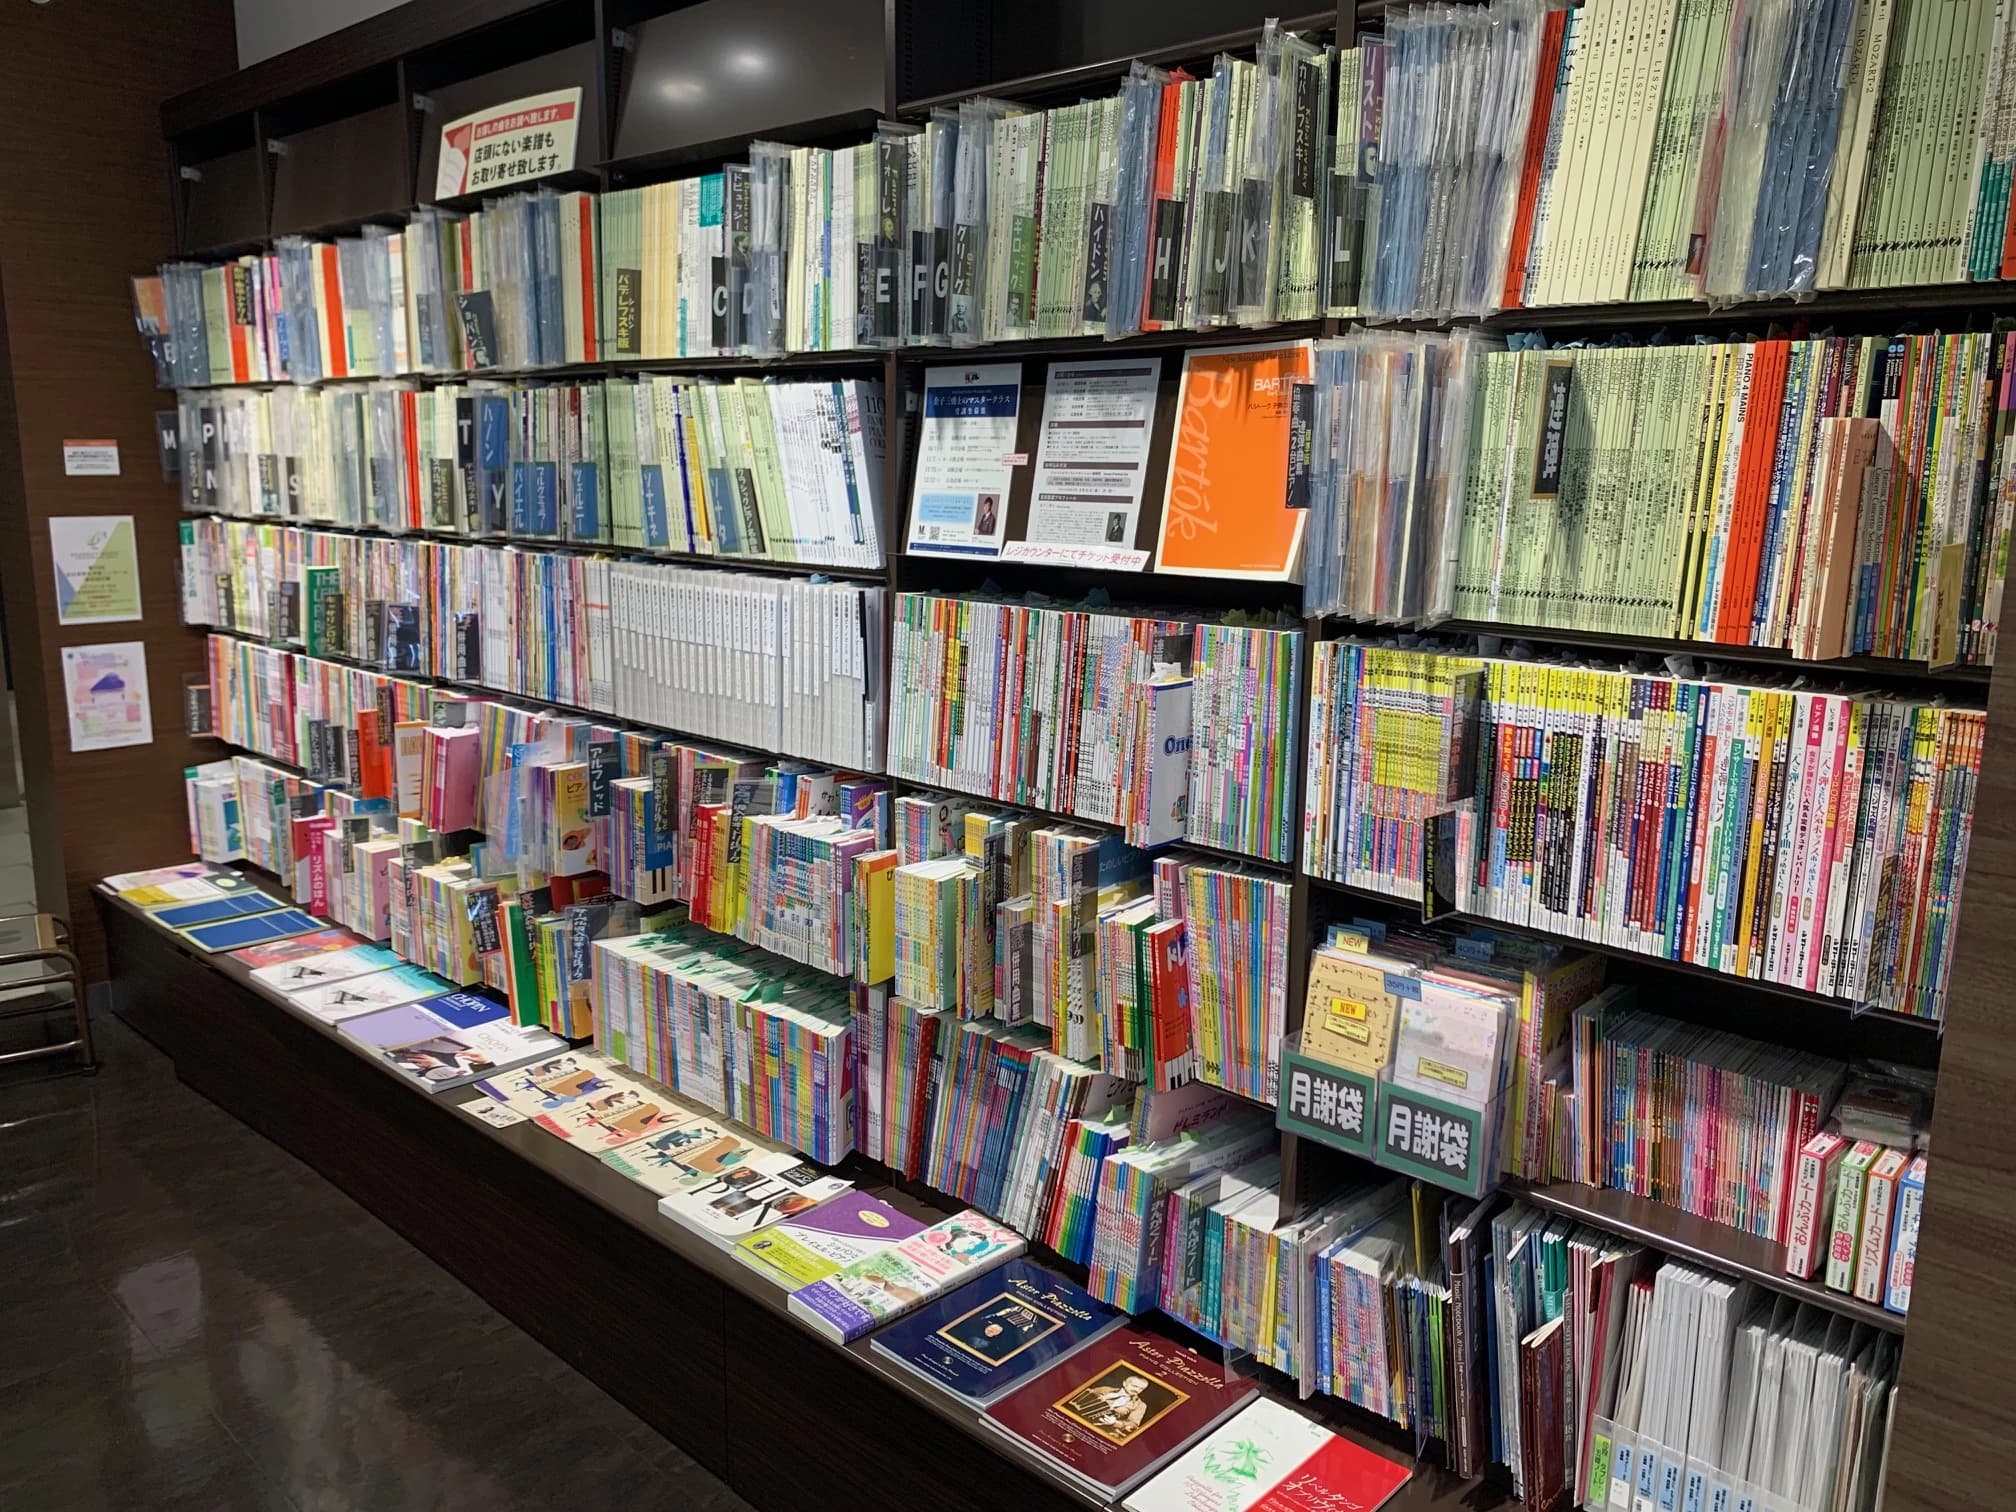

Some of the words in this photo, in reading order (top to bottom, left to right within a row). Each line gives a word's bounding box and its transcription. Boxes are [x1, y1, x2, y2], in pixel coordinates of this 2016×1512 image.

[1296, 64, 1308, 177] カバレフスキー
[474, 131, 555, 164] 店頭にない楽譜も
[471, 153, 562, 186] お取り寄せ致します。
[881, 144, 892, 214] フォーレ
[1010, 219, 1023, 290] ギロック
[1090, 205, 1104, 280] ハイドン
[1153, 237, 1171, 280] H
[1334, 215, 1351, 263] L
[876, 268, 891, 304] E
[913, 264, 928, 301] F
[934, 261, 948, 298] G
[458, 296, 479, 348] ショパン
[617, 274, 631, 349] パデレフスキ版
[712, 285, 728, 318] C
[1743, 352, 1754, 383] PIANO
[1737, 392, 1749, 423] MAINS
[162, 430, 177, 450] M
[202, 423, 215, 445] P
[458, 418, 472, 446] T
[483, 402, 494, 462] ハノン
[289, 475, 299, 496] S
[491, 483, 505, 509] Y
[512, 467, 524, 529] バイエル
[572, 469, 585, 532] ツェルニー
[642, 473, 659, 540] ソナチネ
[710, 475, 728, 543] ソナタ
[1005, 543, 1142, 567] レジカウンターにてチケット受付中
[1811, 703, 1824, 740] ピアノ連弾
[589, 747, 604, 814] アルフレッド
[311, 854, 326, 908] リズムのほん
[1342, 935, 1362, 949] NEW
[451, 993, 491, 1013] CHOPIN
[1339, 1002, 1358, 1016] NEW
[1172, 1102, 1229, 1133] ドレミランド
[1288, 1070, 1364, 1135] 月謝袋
[1387, 1102, 1470, 1171] 月謝袋
[1794, 1181, 1816, 1246] おんぷカード
[1837, 1168, 1854, 1232] おんぷカード
[1147, 1200, 1165, 1267] おんがくノート
[1184, 1218, 1201, 1288] おんがくノート
[1864, 1205, 1884, 1267] リズムカード
[1007, 1278, 1041, 1295] Astor
[1043, 1291, 1093, 1322] Piazzolla
[1456, 1302, 1465, 1337] Notebook
[1128, 1340, 1164, 1358] Astor
[1166, 1355, 1225, 1391] Piazzolla
[1138, 1352, 1159, 1366] PIANO
[1159, 1362, 1199, 1387] COLLECTION
[1300, 1473, 1365, 1511] リベルタンゴ
